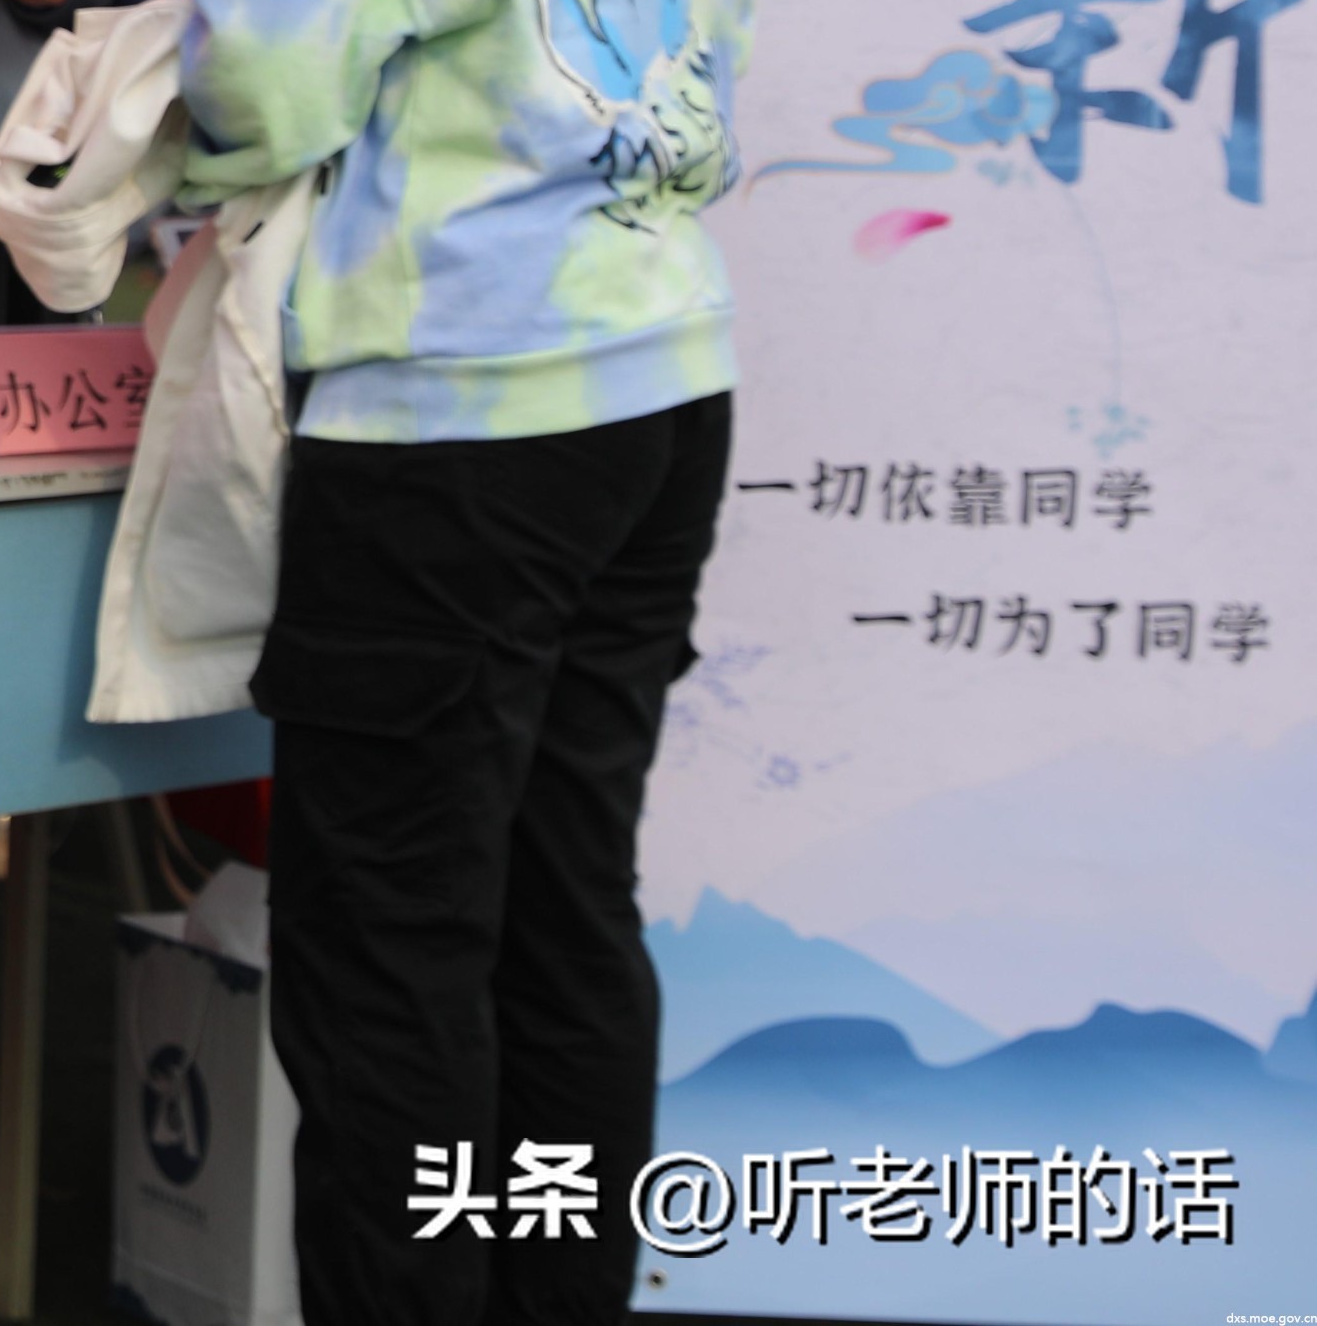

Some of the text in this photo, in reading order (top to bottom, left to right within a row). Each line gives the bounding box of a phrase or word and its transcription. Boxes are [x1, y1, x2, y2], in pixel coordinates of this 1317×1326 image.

[737, 460, 1153, 531] 一切依靠同学
[852, 593, 1272, 664] 一切为了同学
